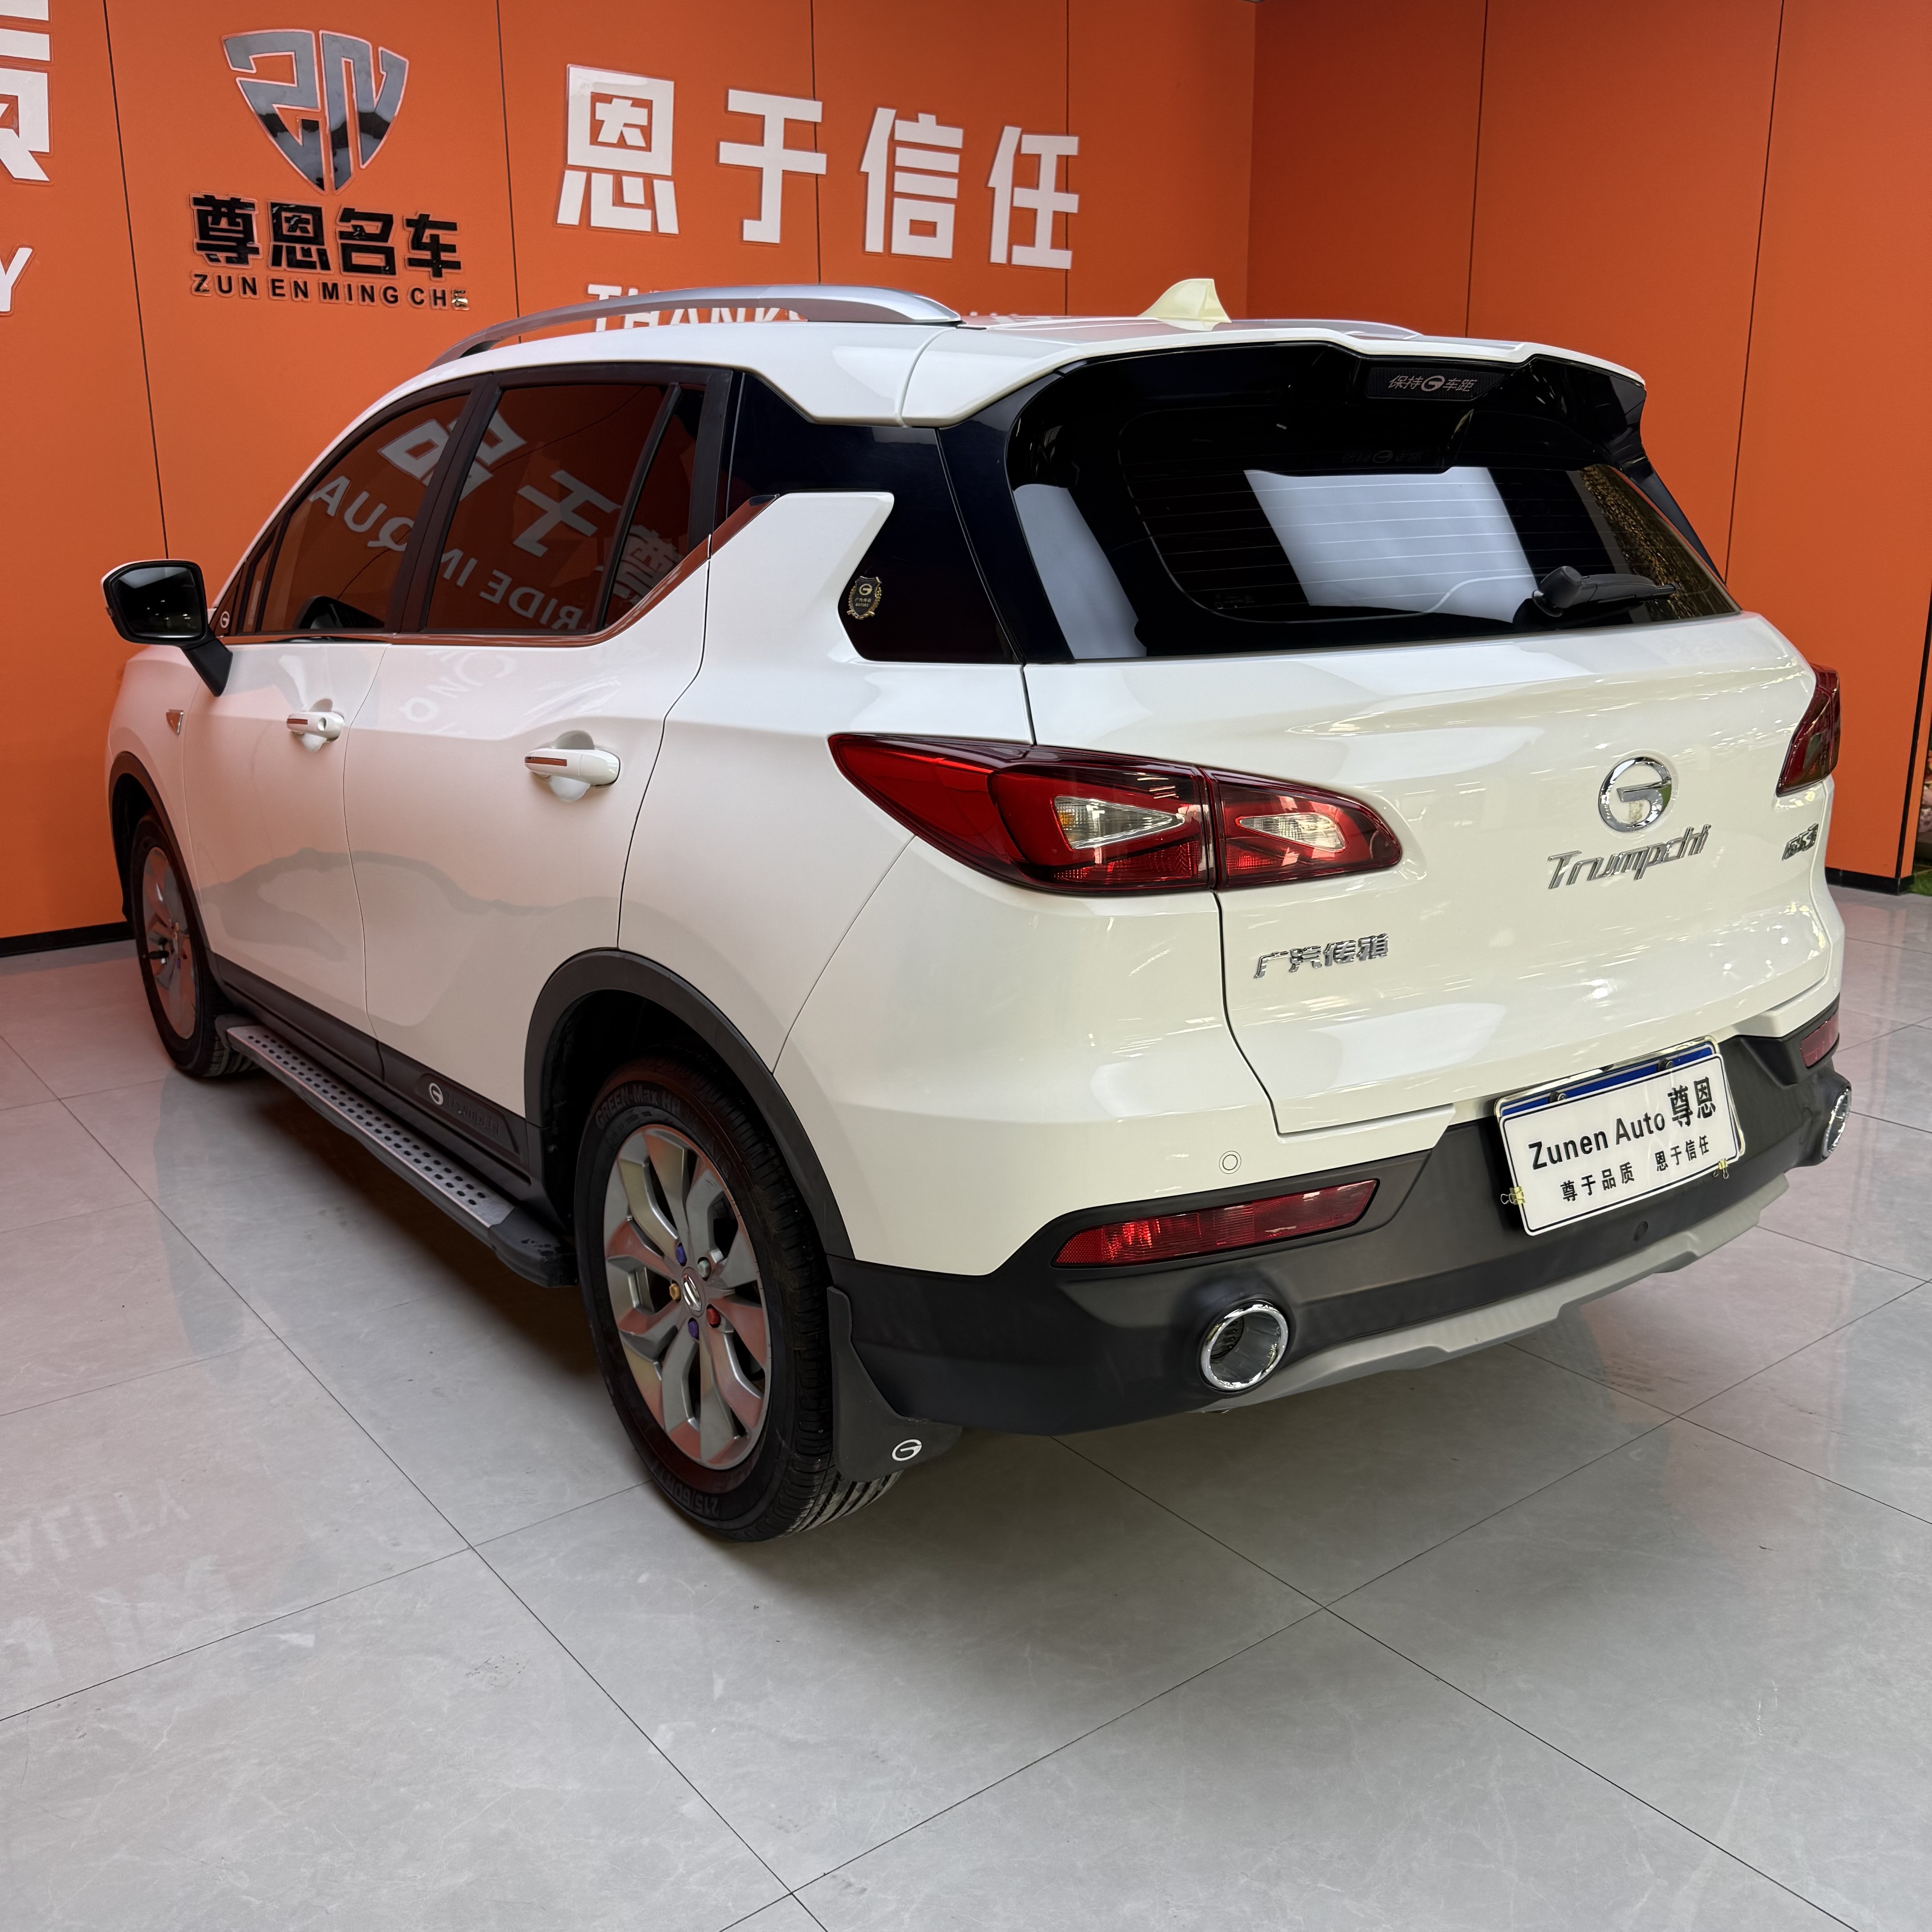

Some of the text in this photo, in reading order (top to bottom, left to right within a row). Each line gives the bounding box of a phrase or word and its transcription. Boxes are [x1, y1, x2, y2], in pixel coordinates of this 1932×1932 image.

[557, 64, 1079, 270] 恩于信任
[192, 194, 461, 279] 尊恩名车
[1547, 824, 1712, 889] Trumpchi
[1528, 1076, 1716, 1170] Zunen Auto 尊恩
[1559, 1135, 1710, 1202] 尊于品质 恩于信任
